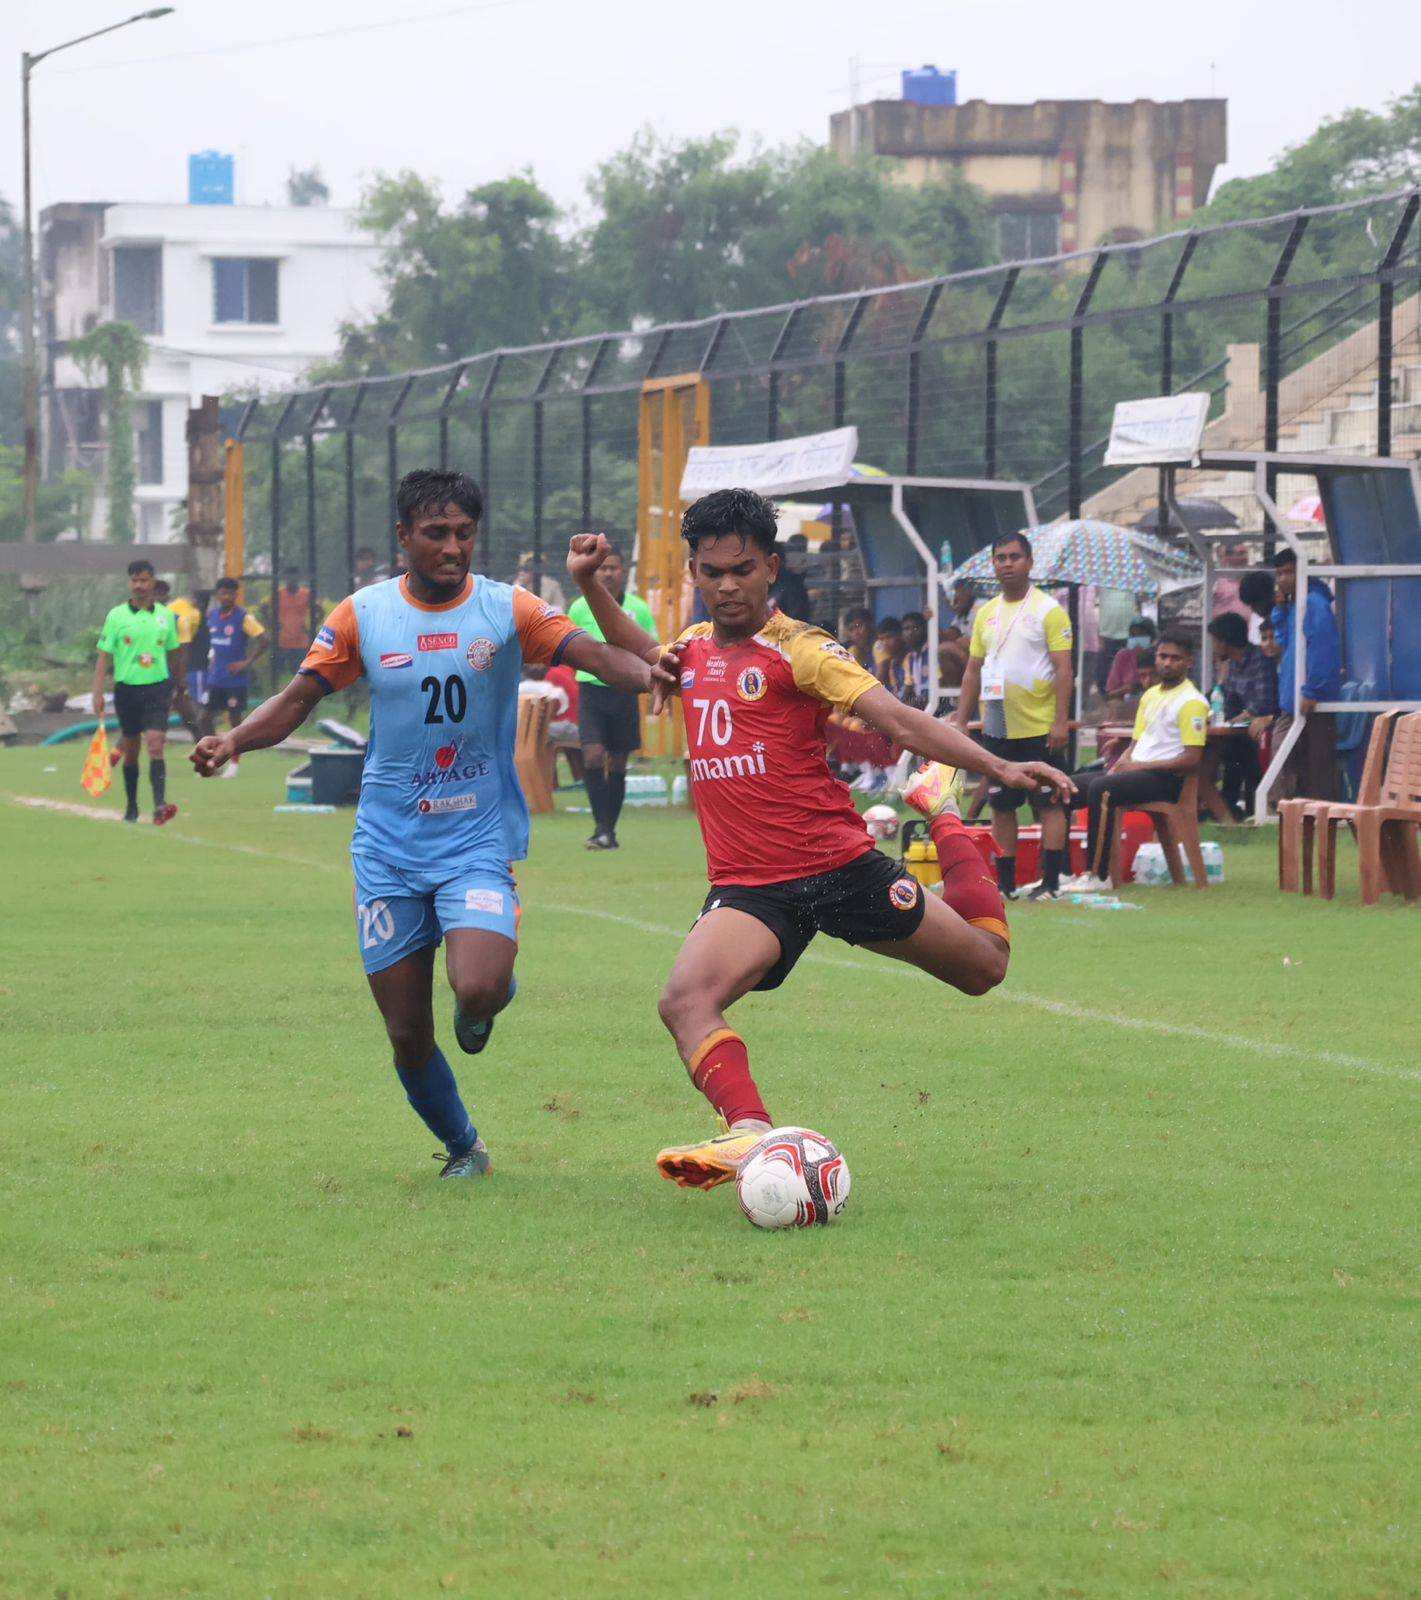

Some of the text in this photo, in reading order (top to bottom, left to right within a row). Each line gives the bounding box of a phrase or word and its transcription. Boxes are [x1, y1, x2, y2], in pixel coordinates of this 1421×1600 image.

[427, 636, 456, 646] SENCO
[421, 674, 467, 724] 20
[692, 699, 733, 746] 70
[358, 900, 395, 949] 20
